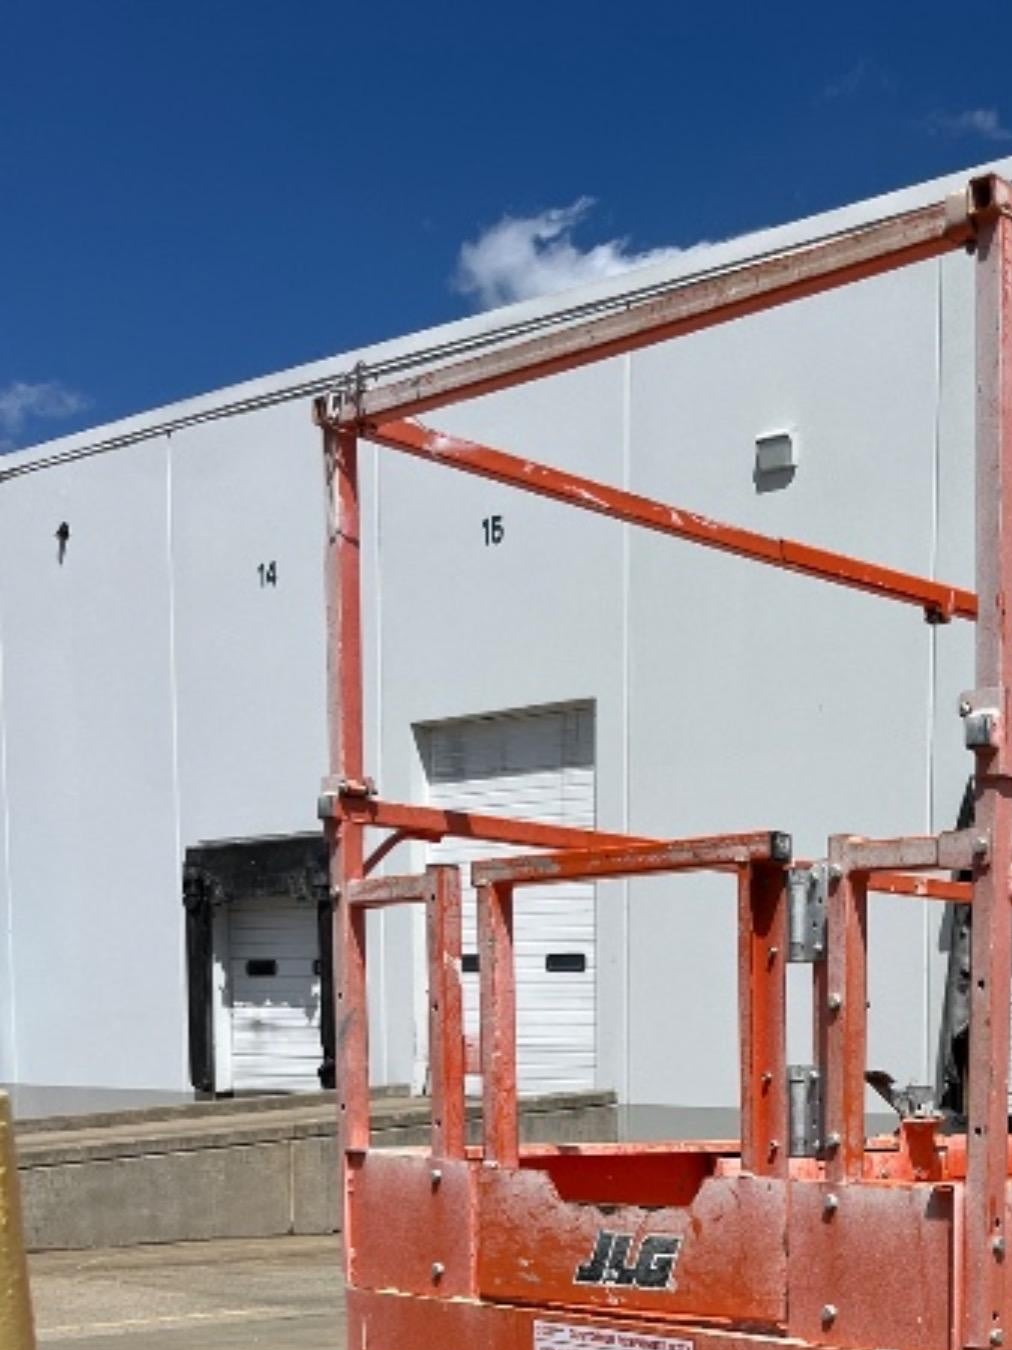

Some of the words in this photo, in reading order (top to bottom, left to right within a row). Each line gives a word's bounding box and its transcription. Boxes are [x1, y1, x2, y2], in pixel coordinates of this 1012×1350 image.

[482, 515, 504, 546] 15
[257, 560, 276, 588] 14
[573, 1230, 684, 1290] JLG
